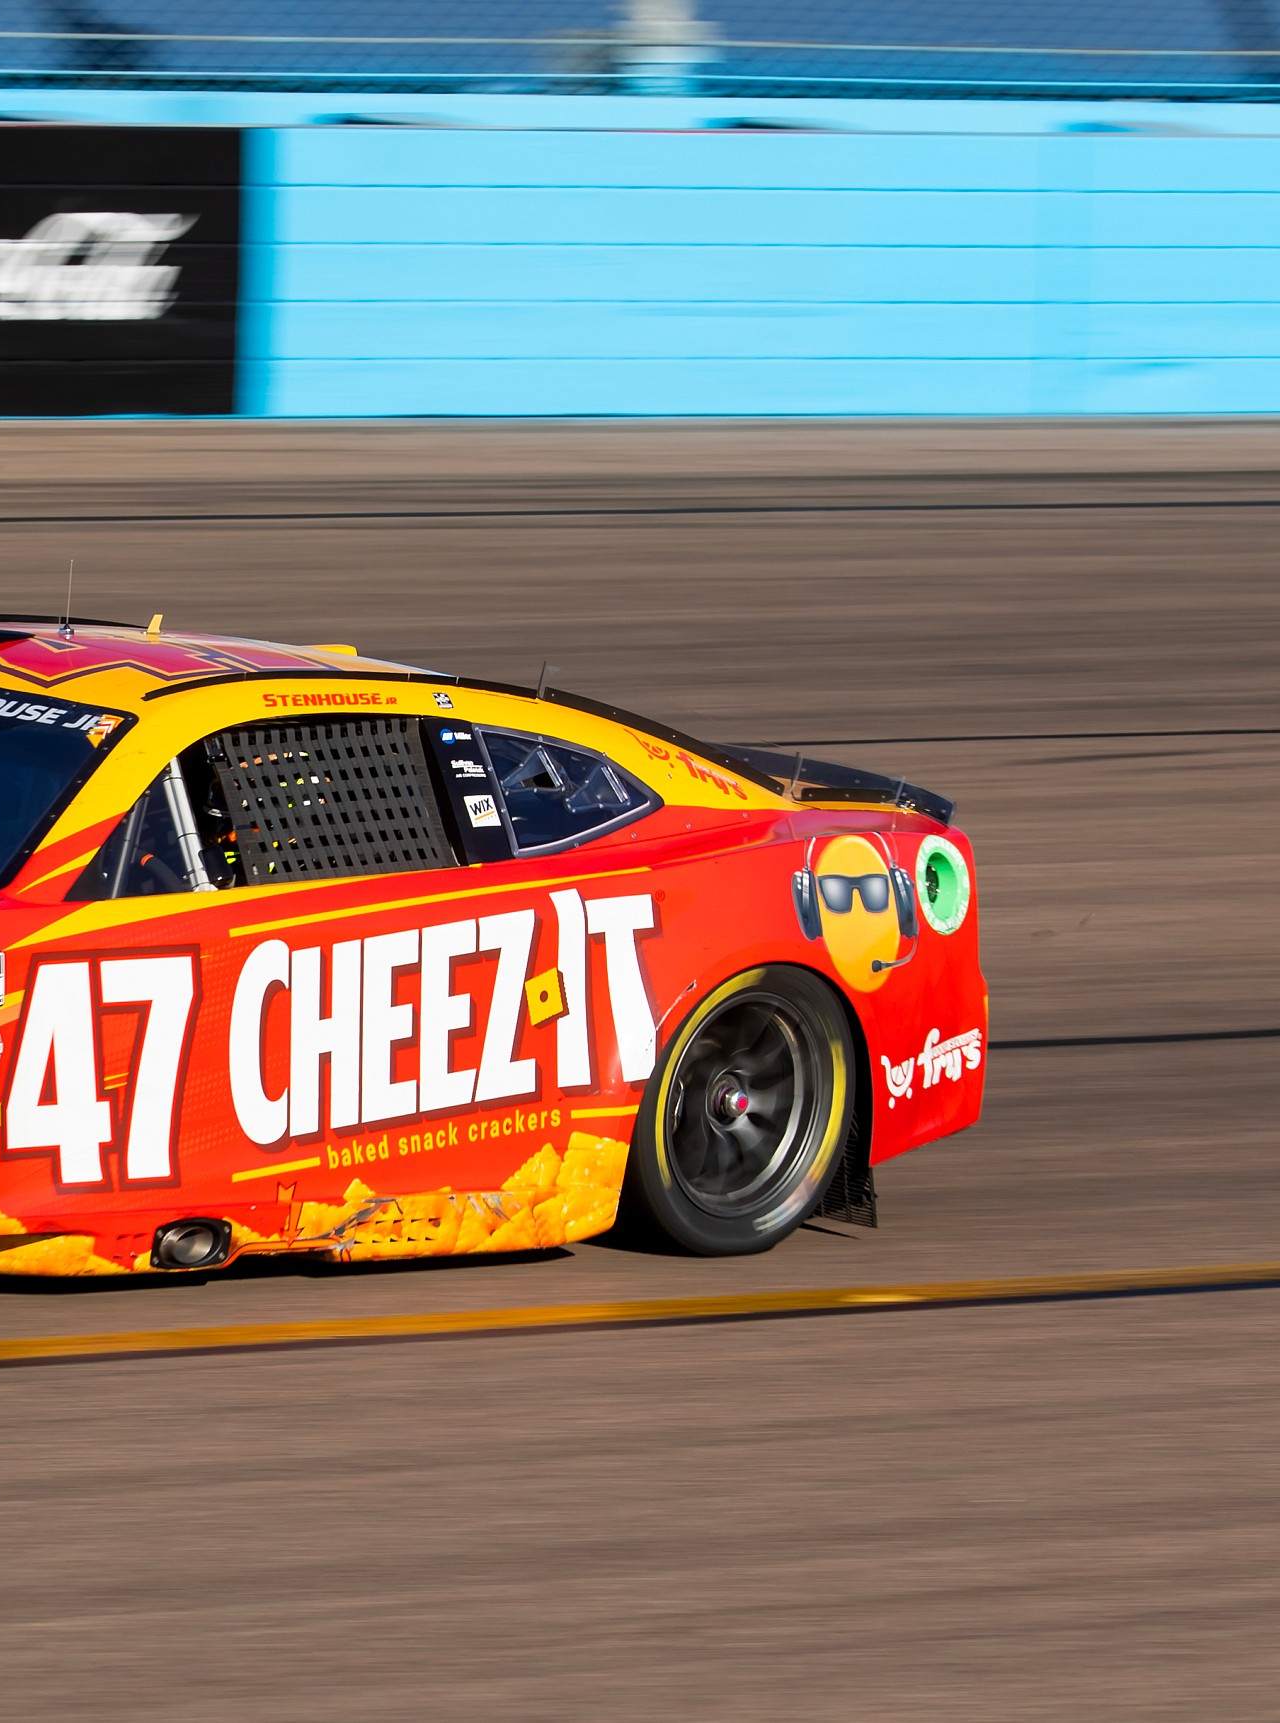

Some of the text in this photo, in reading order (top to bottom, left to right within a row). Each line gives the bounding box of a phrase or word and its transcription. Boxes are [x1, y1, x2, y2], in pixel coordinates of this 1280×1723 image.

[262, 693, 382, 708] STENHOUSE
[469, 797, 494, 816] WIX
[5, 954, 196, 1187] 47
[327, 1108, 562, 1169] baked snack crackers
